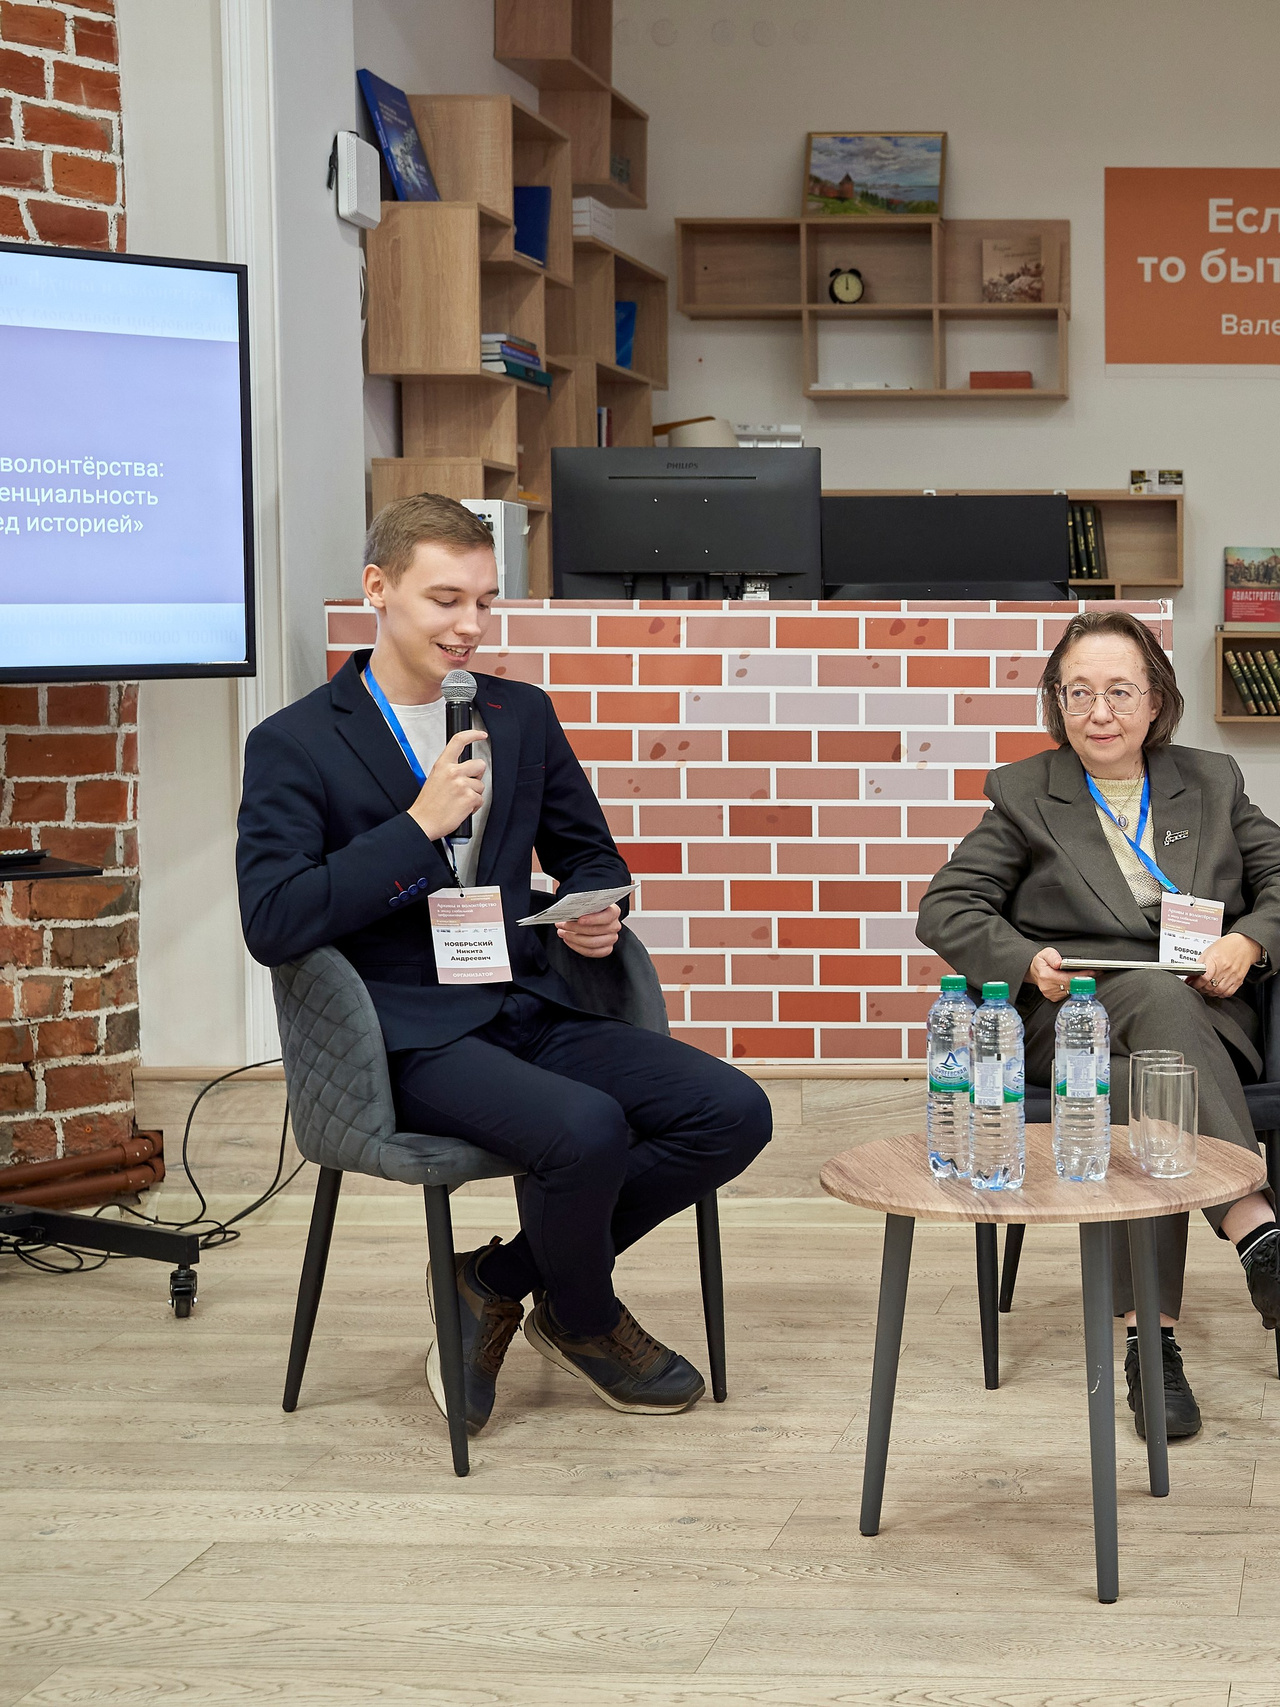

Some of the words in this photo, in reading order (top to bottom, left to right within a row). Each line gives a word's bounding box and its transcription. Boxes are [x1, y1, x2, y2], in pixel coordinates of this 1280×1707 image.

[1137, 256, 1186, 284] то
[0, 456, 164, 480] волонтёрства:
[666, 462, 699, 470] PHILIPS
[27, 514, 144, 537] историей»
